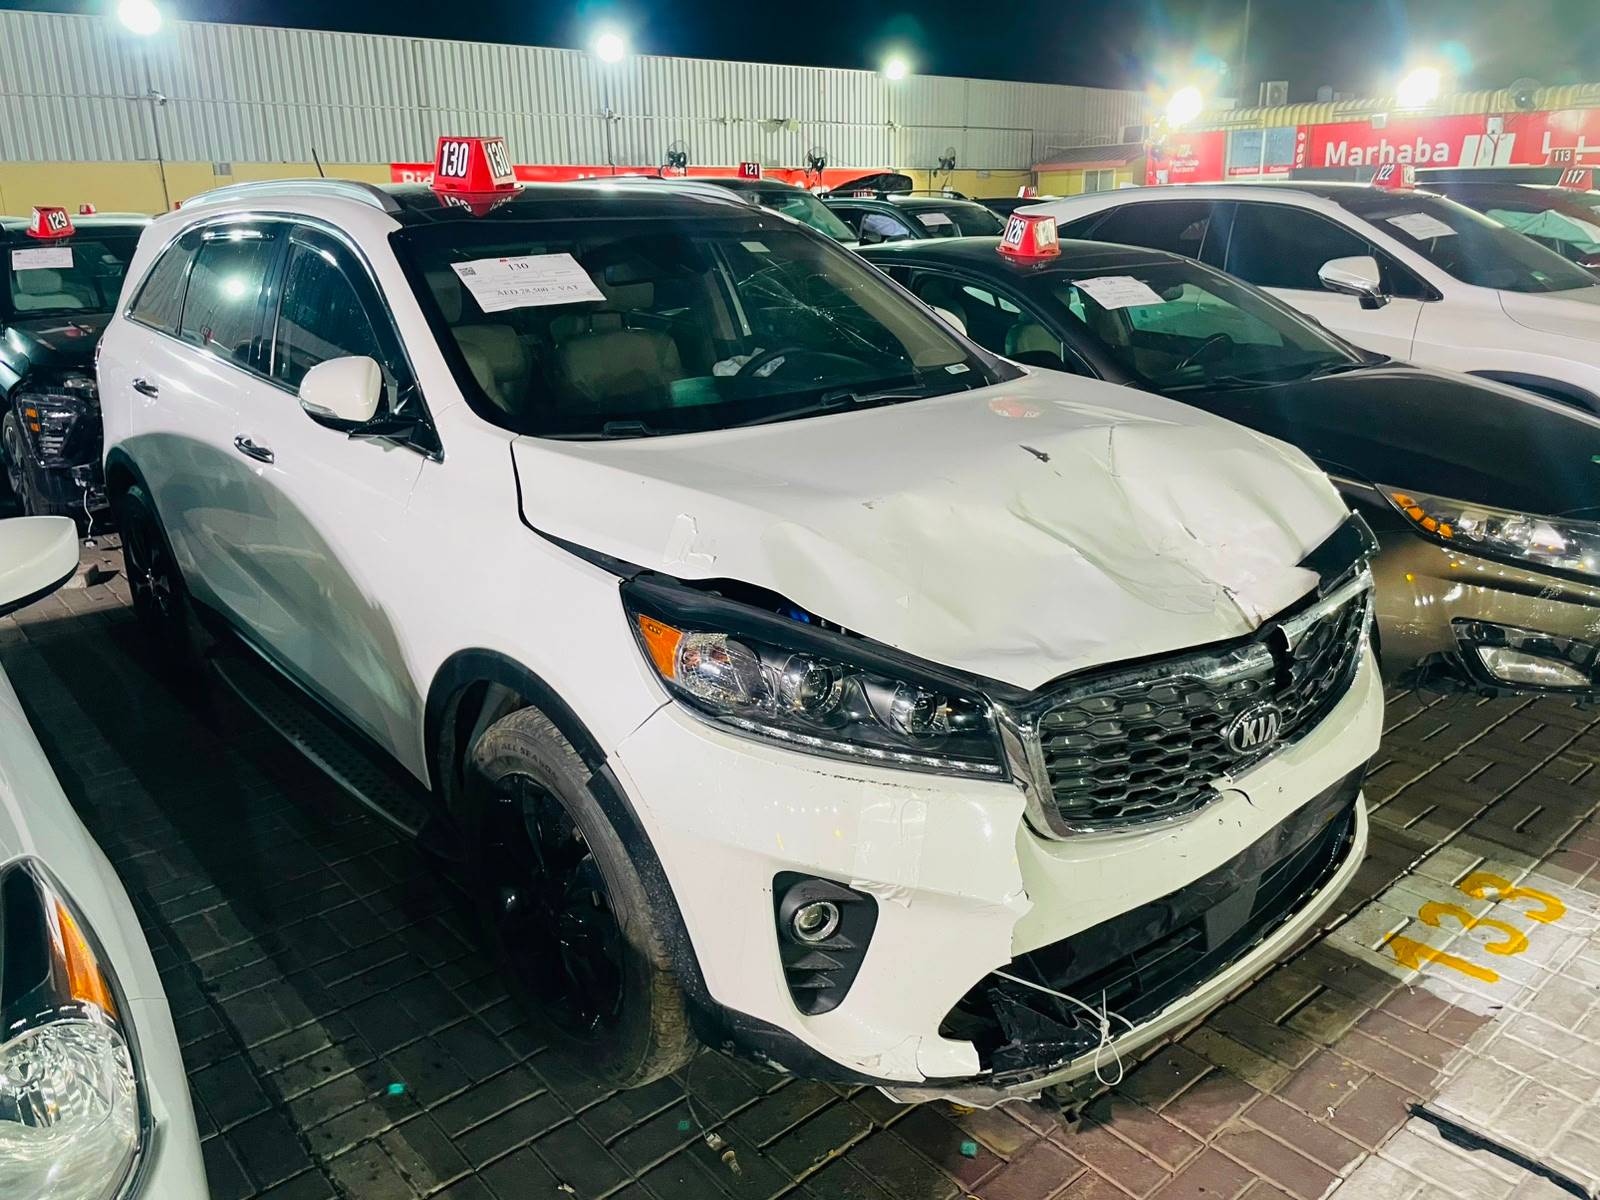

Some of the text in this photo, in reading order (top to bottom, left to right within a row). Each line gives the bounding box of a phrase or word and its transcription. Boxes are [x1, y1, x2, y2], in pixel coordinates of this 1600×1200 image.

[441, 141, 469, 177] 130
[487, 141, 511, 178] 130
[1324, 137, 1450, 167] Marhaba
[1554, 149, 1571, 162] 113
[744, 163, 759, 176] 121
[1376, 163, 1395, 181] 122
[1564, 169, 1586, 184] 117
[48, 210, 67, 231] 129
[1006, 216, 1025, 245] 126
[508, 262, 529, 271] 130
[1241, 712, 1277, 748] KIA
[1383, 872, 1568, 984] 133
